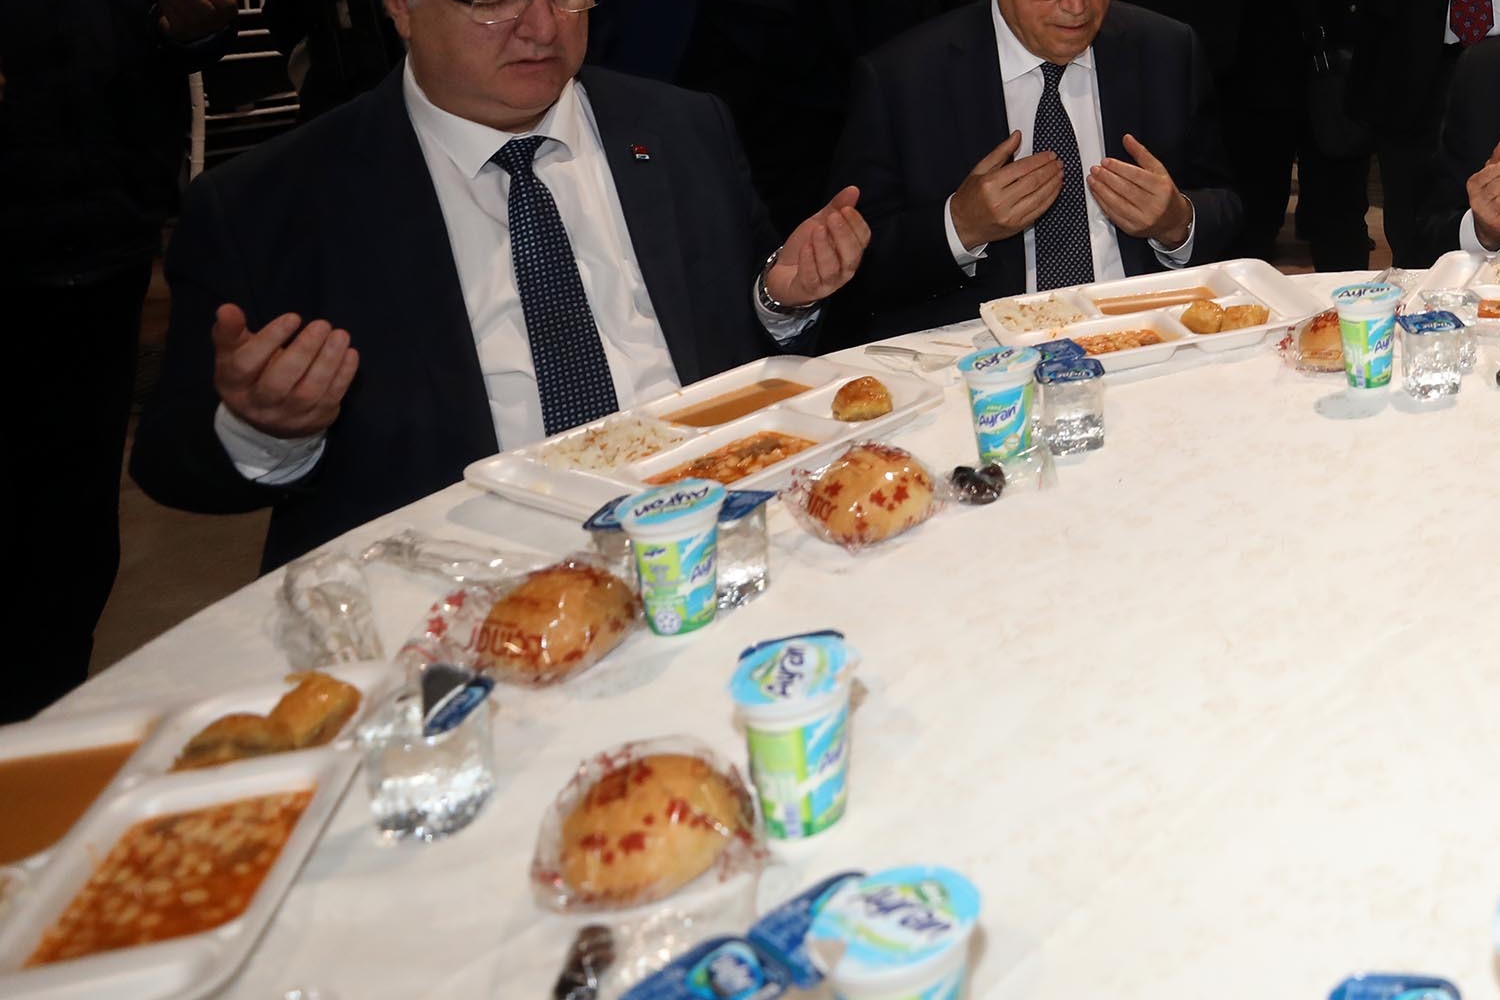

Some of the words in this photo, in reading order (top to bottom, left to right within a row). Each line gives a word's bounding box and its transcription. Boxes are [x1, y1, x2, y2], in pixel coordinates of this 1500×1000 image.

[1338, 286, 1391, 299] Ayran
[979, 405, 1016, 427] Ayran
[633, 486, 710, 518] Ayran
